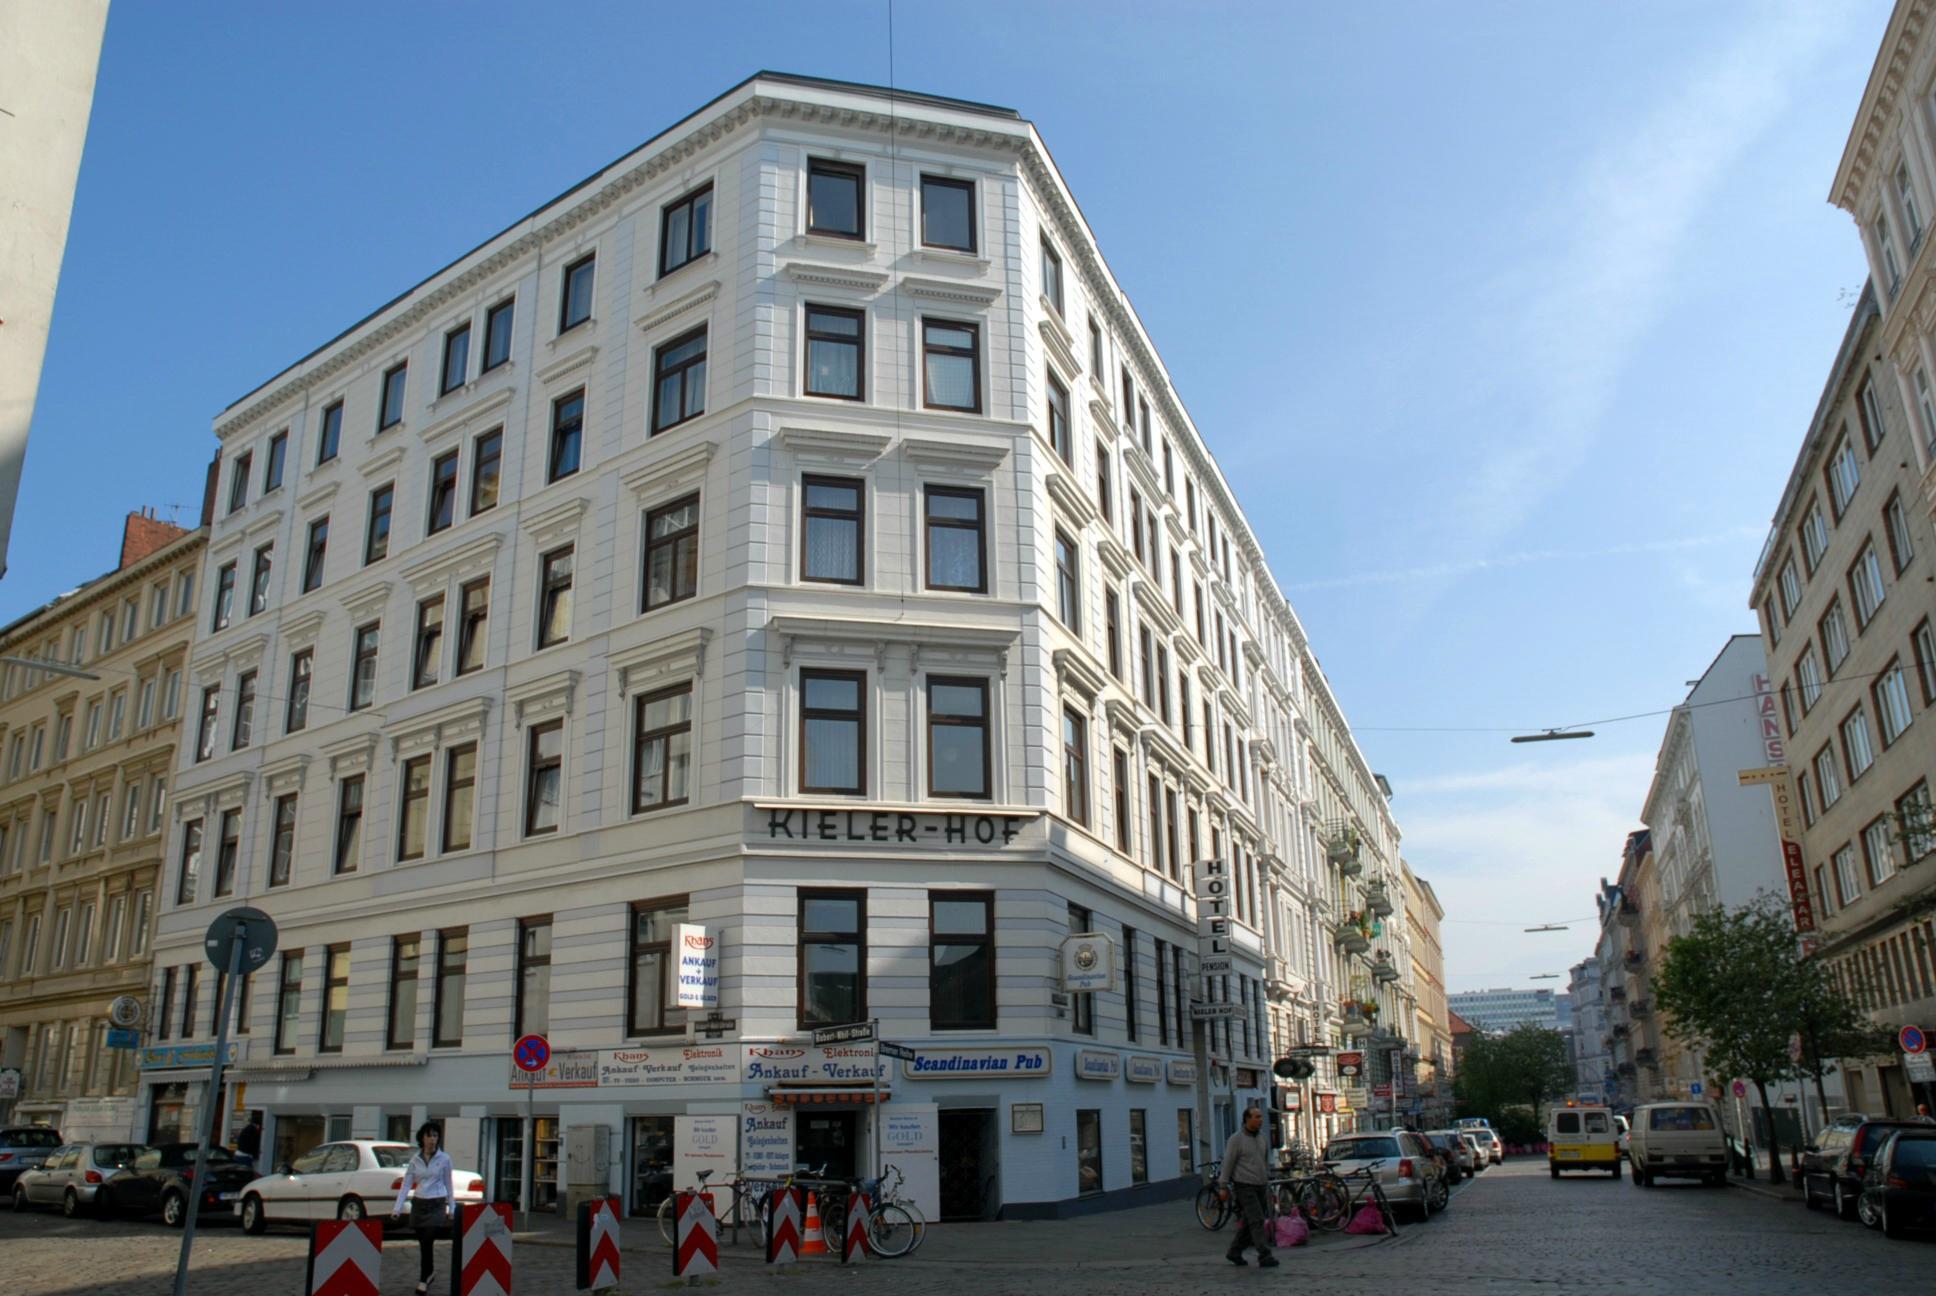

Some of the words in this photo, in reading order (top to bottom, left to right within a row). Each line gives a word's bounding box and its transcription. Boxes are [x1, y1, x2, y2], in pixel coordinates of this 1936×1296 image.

[1777, 784, 1793, 838] HOTEL
[768, 809, 1020, 845] KIELER-HOF
[1207, 861, 1227, 953] HOTEL
[682, 956, 717, 968] ANKAUF
[1201, 961, 1229, 972] PENSION
[680, 975, 720, 986] VERKAUF
[1313, 1003, 1322, 1041] HOTEL
[614, 1051, 649, 1063] Khans
[822, 1047, 875, 1059] Elektroni
[601, 1065, 638, 1075] Ankauf
[643, 1063, 683, 1074] Verkauf
[914, 1056, 1008, 1071] Scandinavian
[1015, 1055, 1043, 1069] Pub
[559, 1061, 598, 1080] Verkauf
[748, 1063, 809, 1079] Ankauf
[745, 1117, 788, 1133] Ankauf
[692, 1135, 718, 1145] GOLD
[888, 1131, 922, 1142] GOLD
